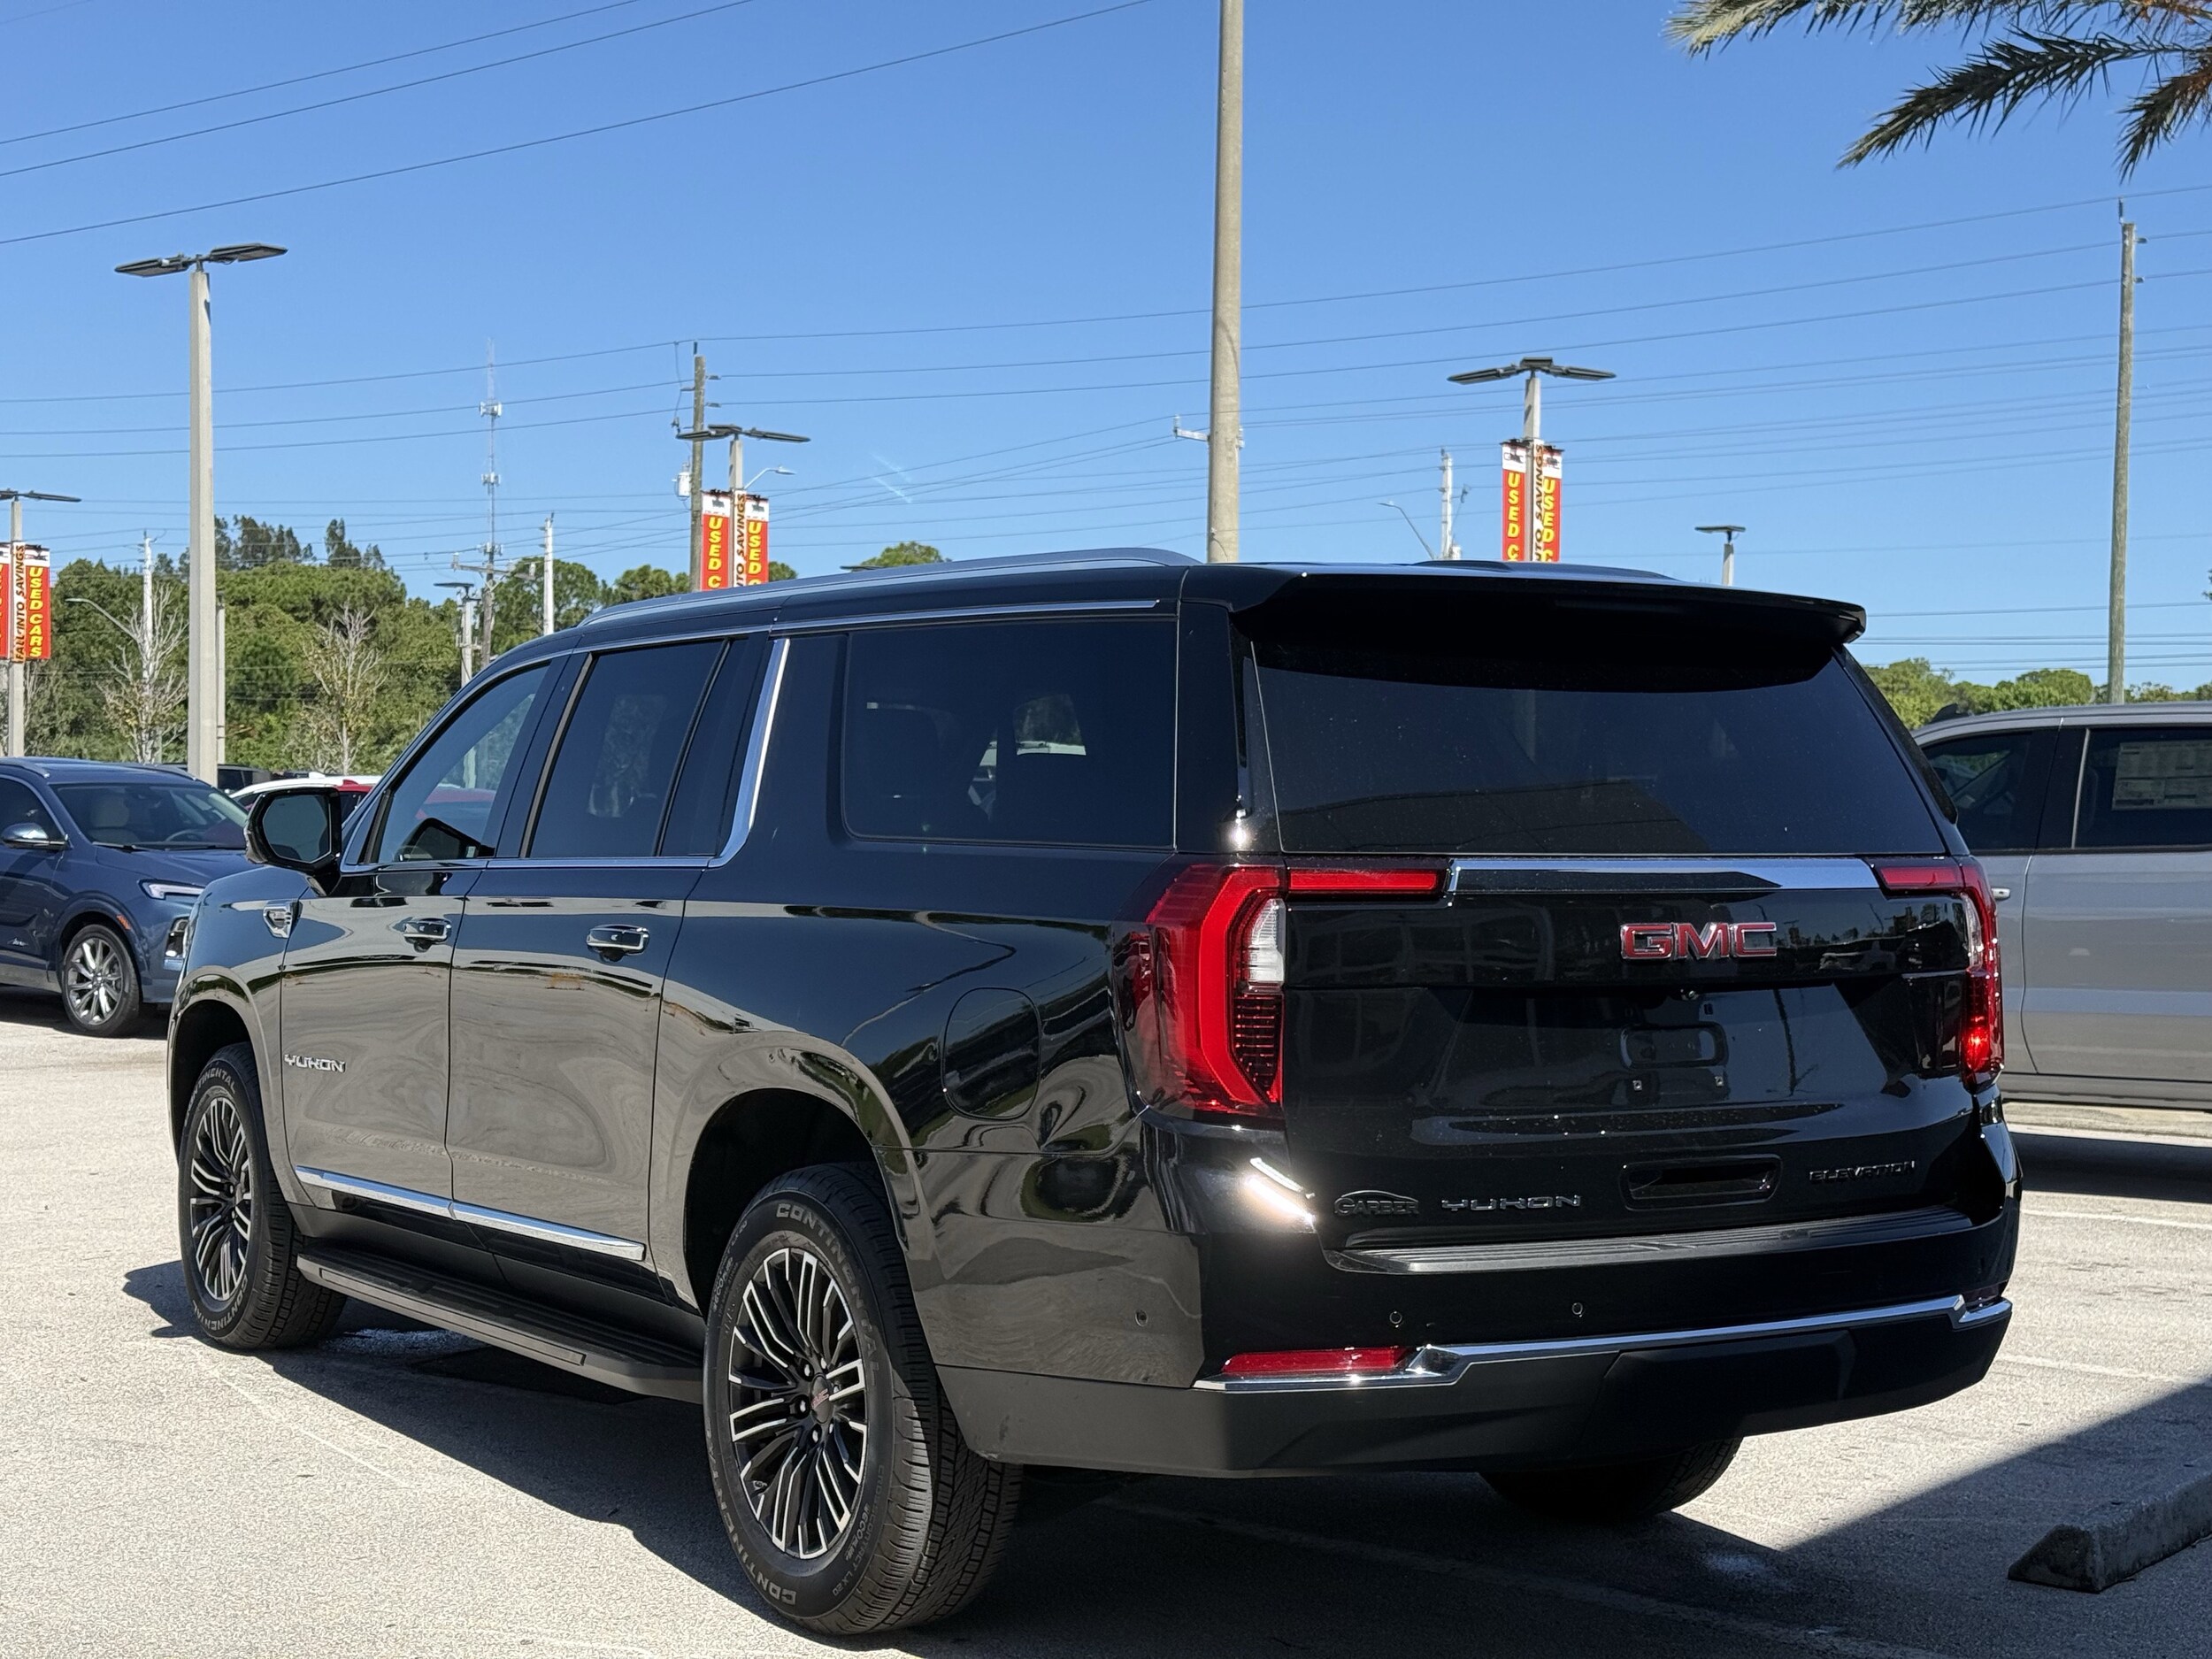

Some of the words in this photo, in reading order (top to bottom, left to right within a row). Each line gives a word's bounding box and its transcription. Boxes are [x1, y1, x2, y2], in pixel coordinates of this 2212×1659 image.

[736, 494, 745, 557] SAVINGS
[1507, 472, 1521, 538] USED
[1543, 479, 1556, 543] USED
[708, 516, 723, 571] USED
[748, 521, 762, 575] USED
[15, 545, 25, 599] SAVINGS
[29, 566, 44, 611] USED
[15, 602, 25, 630] INTO
[29, 614, 44, 657] CARS
[15, 634, 25, 660] FALL
[1620, 922, 1777, 960] GMC
[284, 1054, 347, 1073] YUKON
[1809, 1160, 1916, 1181] ELEVATION
[1333, 1196, 1420, 1217] GARBER
[1441, 1194, 1582, 1212] YUKON
[193, 1274, 248, 1332] CONTINENTAL
[776, 1203, 879, 1386] CONTINENTAL
